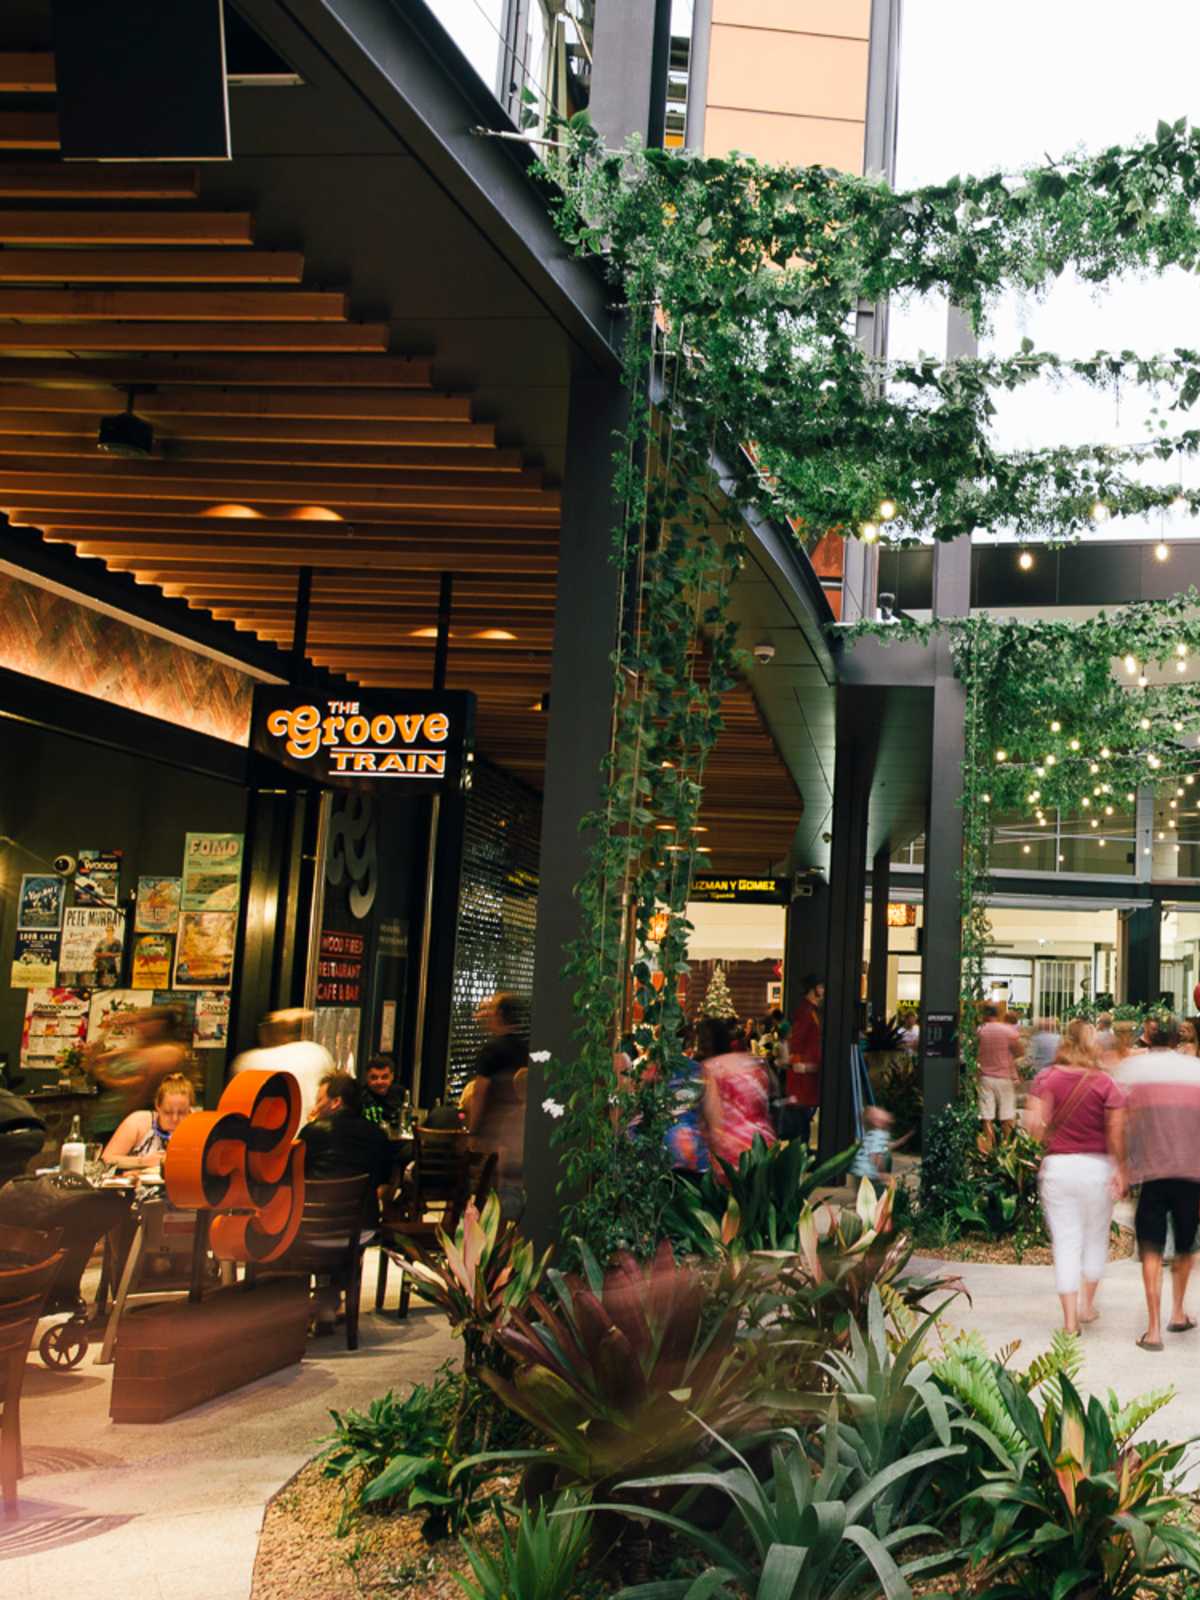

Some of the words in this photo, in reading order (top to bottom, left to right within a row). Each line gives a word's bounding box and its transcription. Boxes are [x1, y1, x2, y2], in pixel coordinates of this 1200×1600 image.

[328, 701, 360, 715] THE
[267, 705, 449, 759] Groove
[329, 752, 445, 774] TRAIN
[189, 840, 240, 857] FOMO
[686, 881, 728, 891] UZMAN
[738, 880, 776, 891] GOMEZ
[66, 910, 86, 928] PETE
[317, 983, 337, 1000] CAFE
